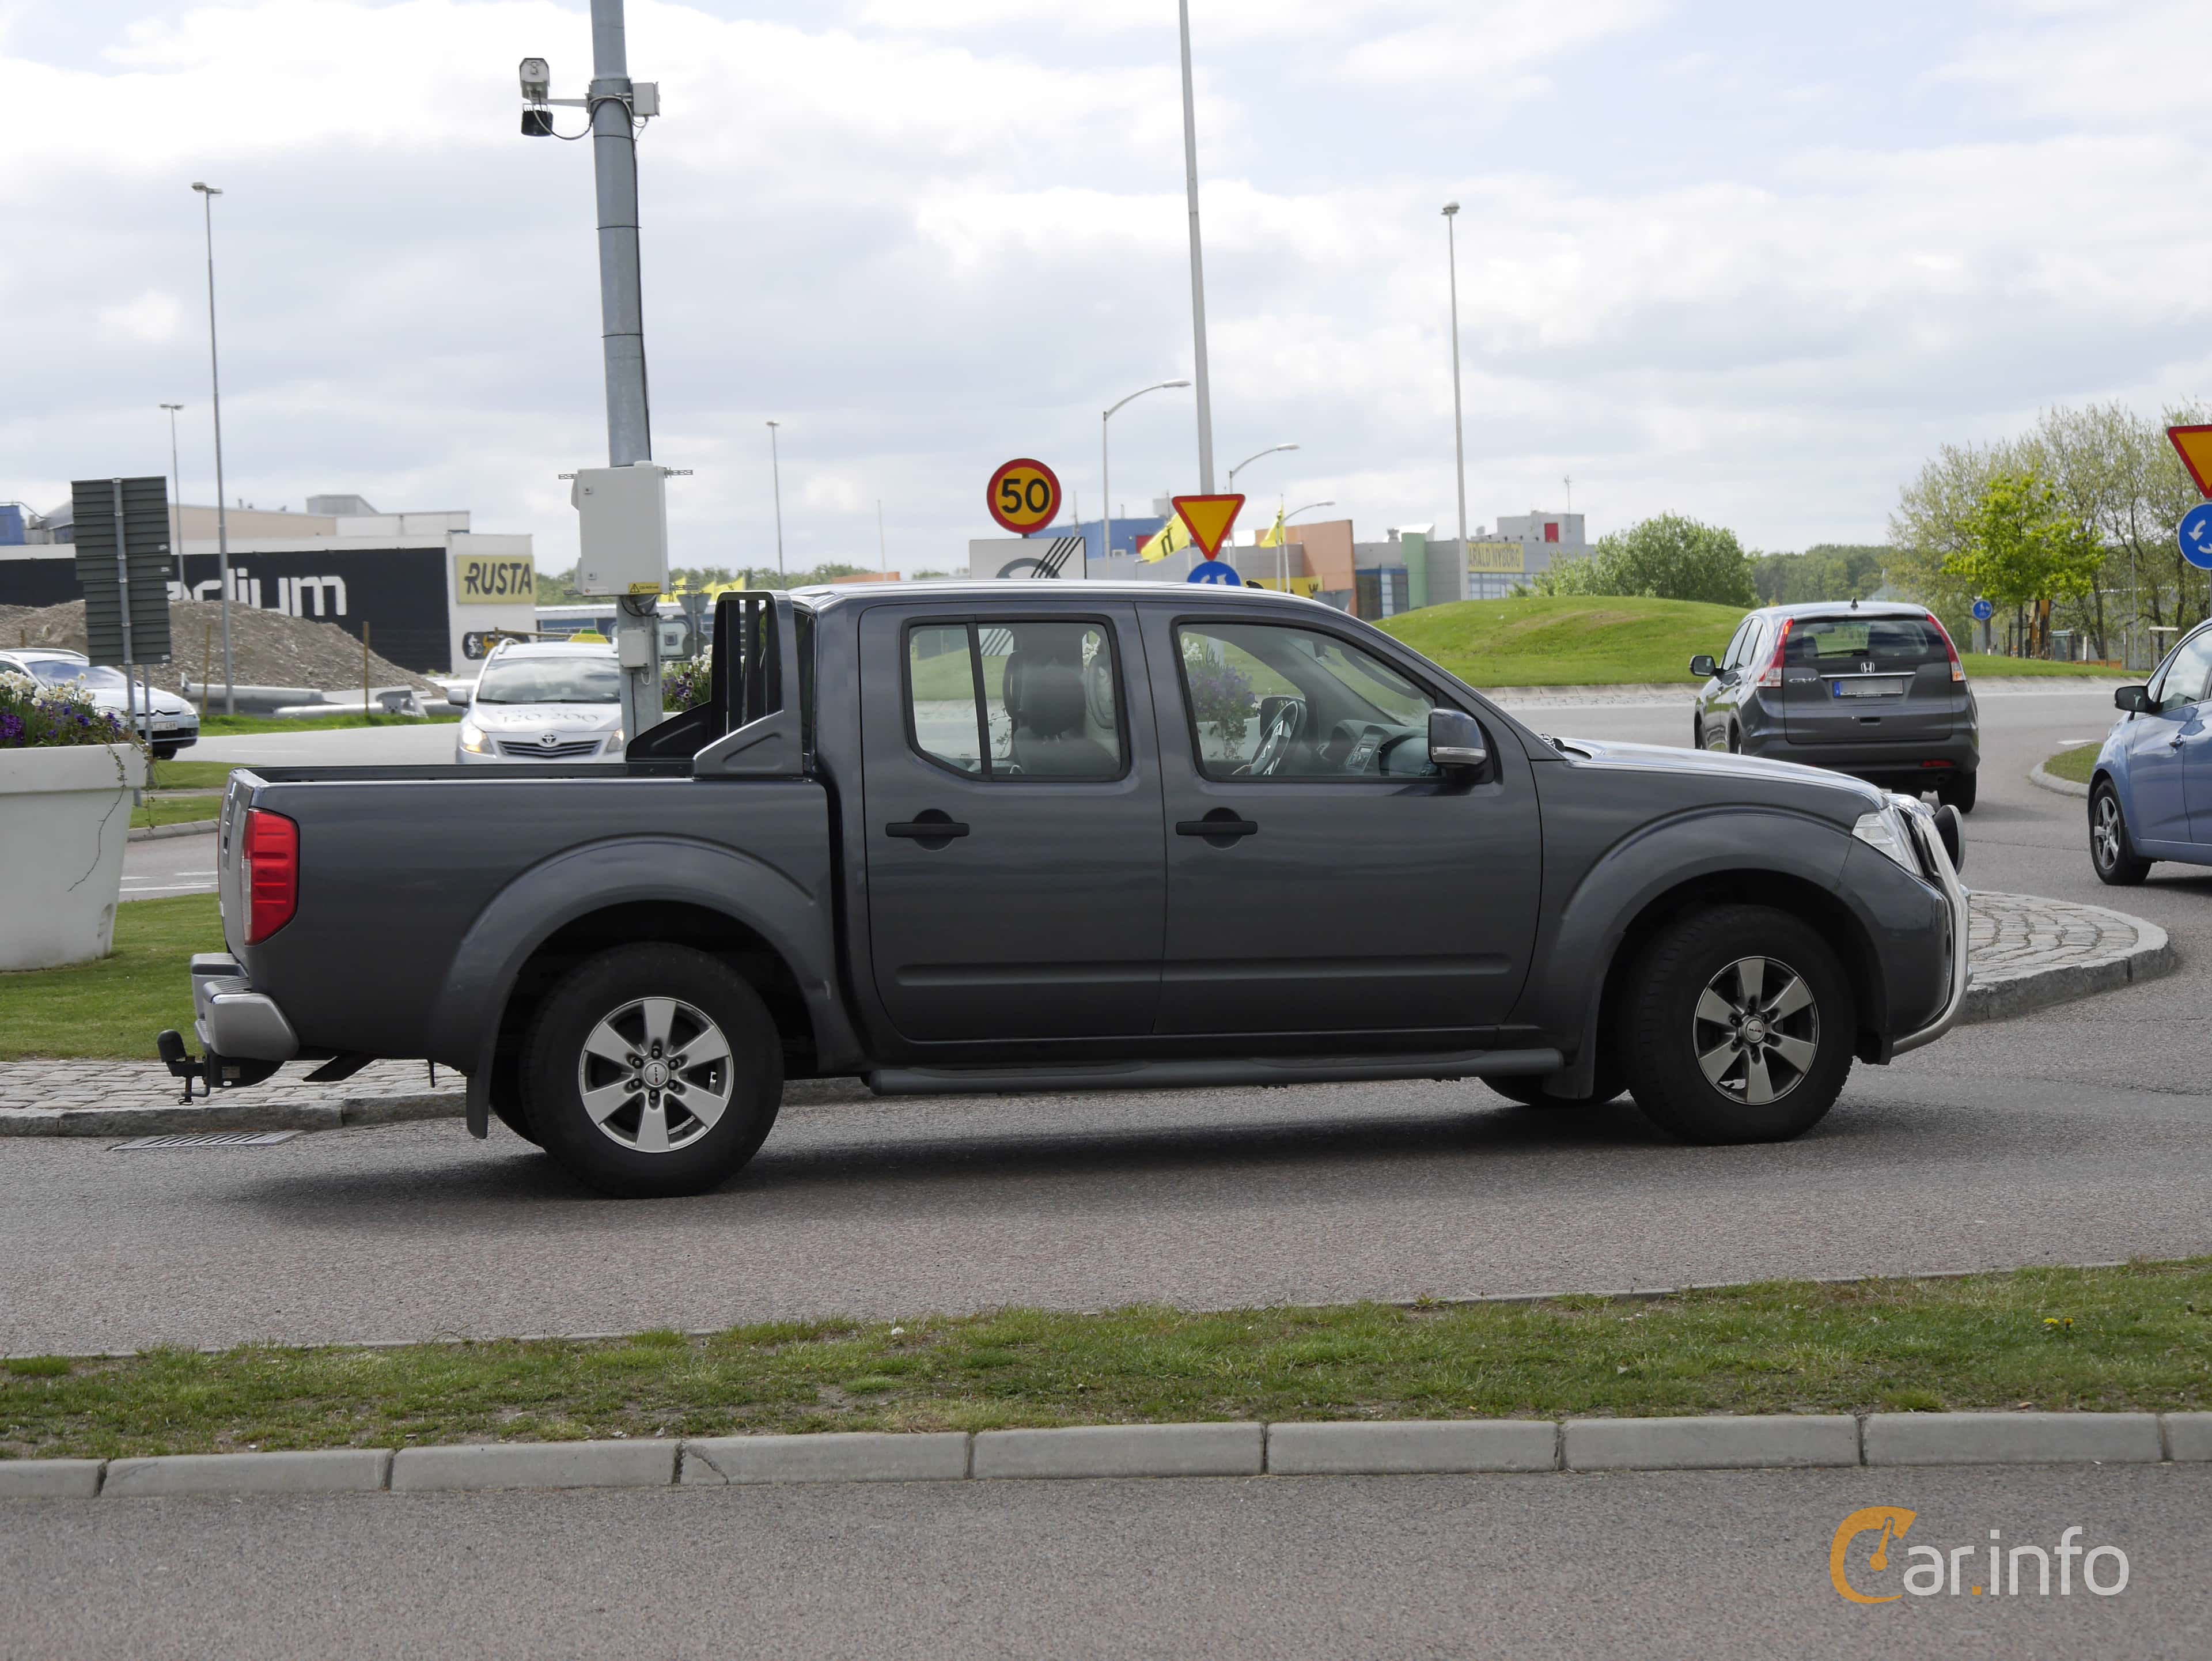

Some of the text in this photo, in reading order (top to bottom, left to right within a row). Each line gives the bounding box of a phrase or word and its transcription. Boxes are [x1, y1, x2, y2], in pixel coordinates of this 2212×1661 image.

[1002, 478, 1050, 513] 50
[1469, 547, 1490, 567] ARALD
[464, 562, 532, 595] RUSTA
